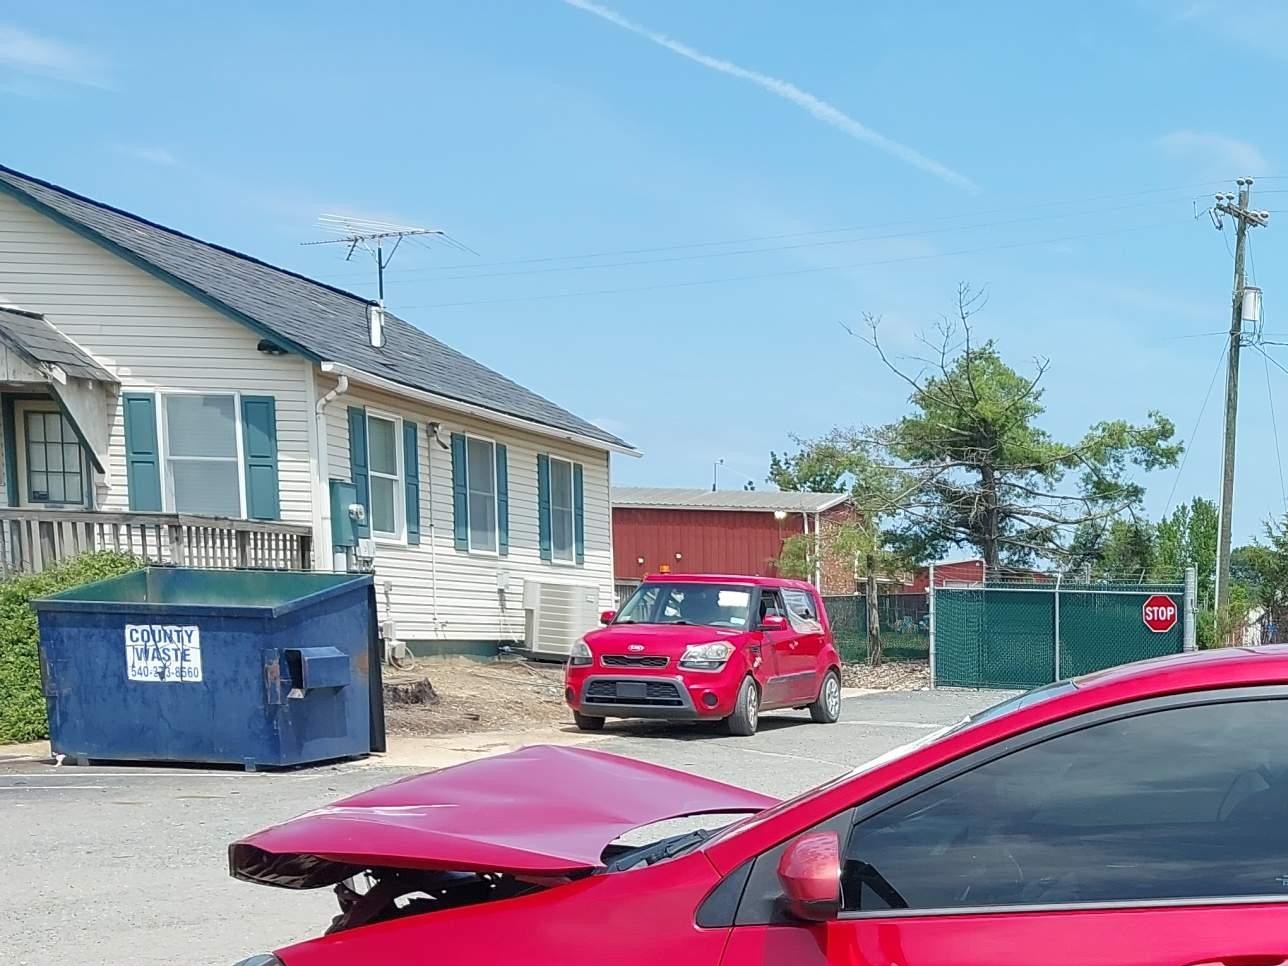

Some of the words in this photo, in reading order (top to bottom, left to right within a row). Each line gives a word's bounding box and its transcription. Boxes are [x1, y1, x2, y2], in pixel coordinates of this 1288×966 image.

[1145, 606, 1175, 621] STOP
[129, 628, 194, 644] COUNTY
[134, 647, 192, 662] WASTE
